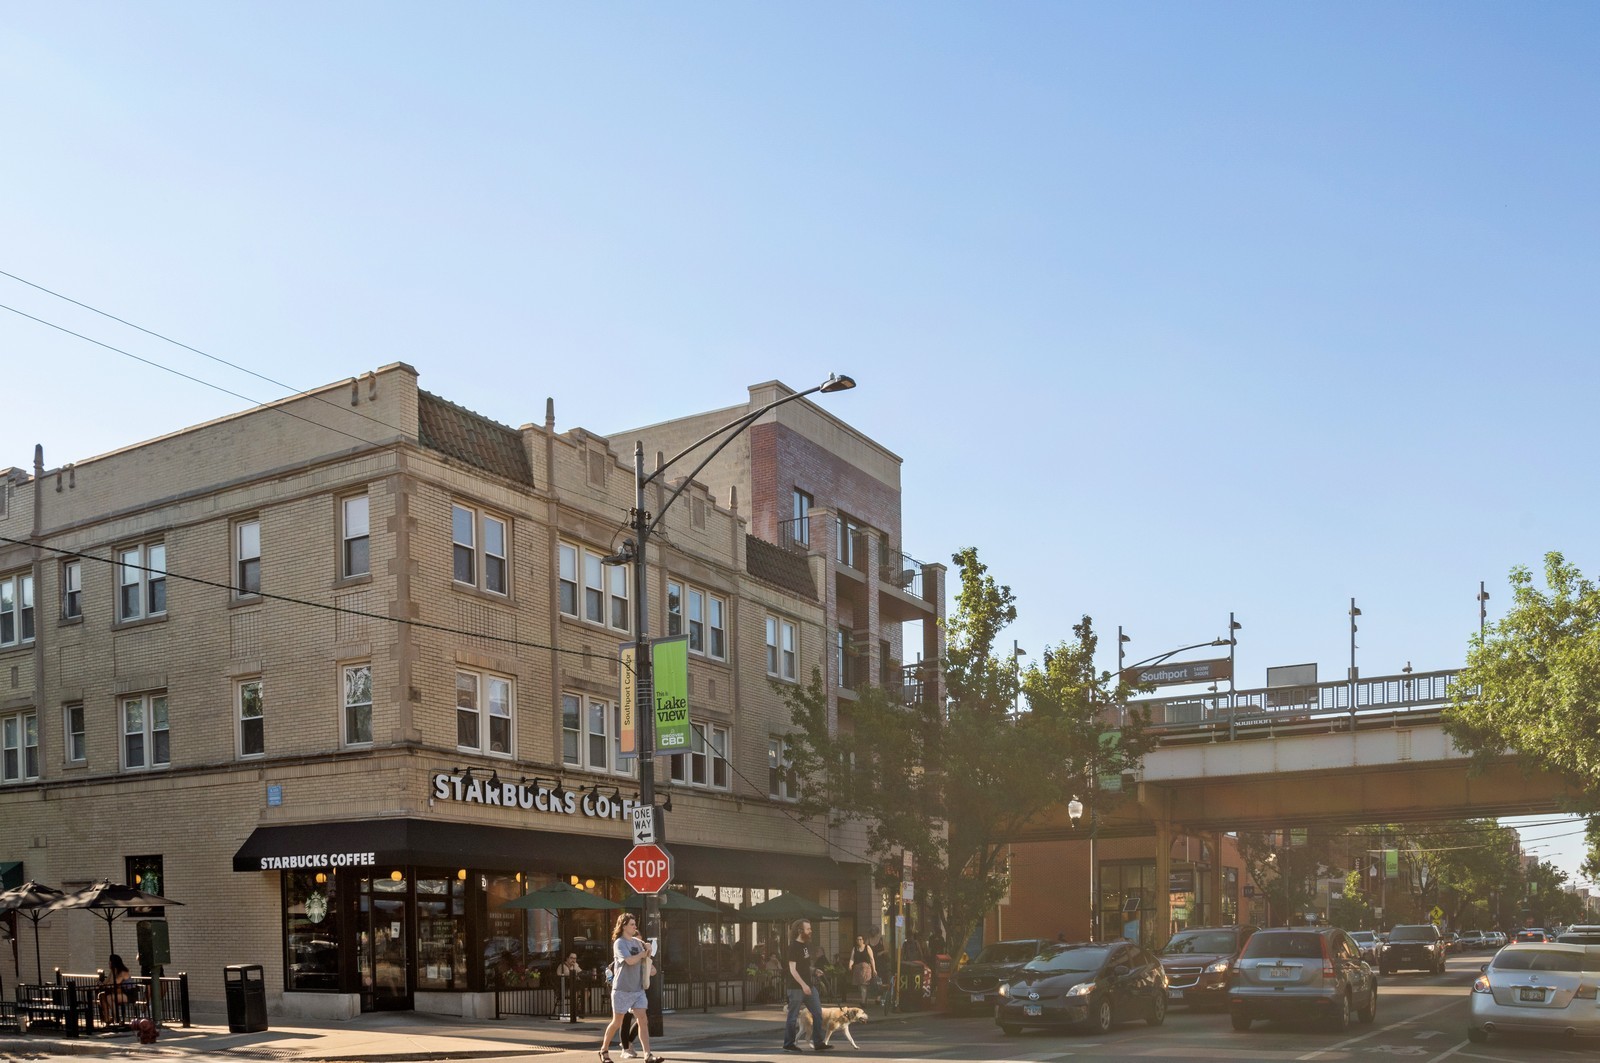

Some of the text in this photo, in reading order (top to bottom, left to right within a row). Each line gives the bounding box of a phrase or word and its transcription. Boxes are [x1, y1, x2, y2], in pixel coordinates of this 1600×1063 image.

[1141, 668, 1187, 682] Southport
[656, 696, 687, 711] Lake
[657, 709, 687, 722] view
[661, 736, 685, 746] CBD
[433, 773, 641, 821] STARBUCKS COFF
[634, 808, 651, 819] ONE
[634, 819, 652, 830] WAY
[260, 852, 375, 870] STARBUCKS COFFEE
[627, 860, 667, 878] STOP
